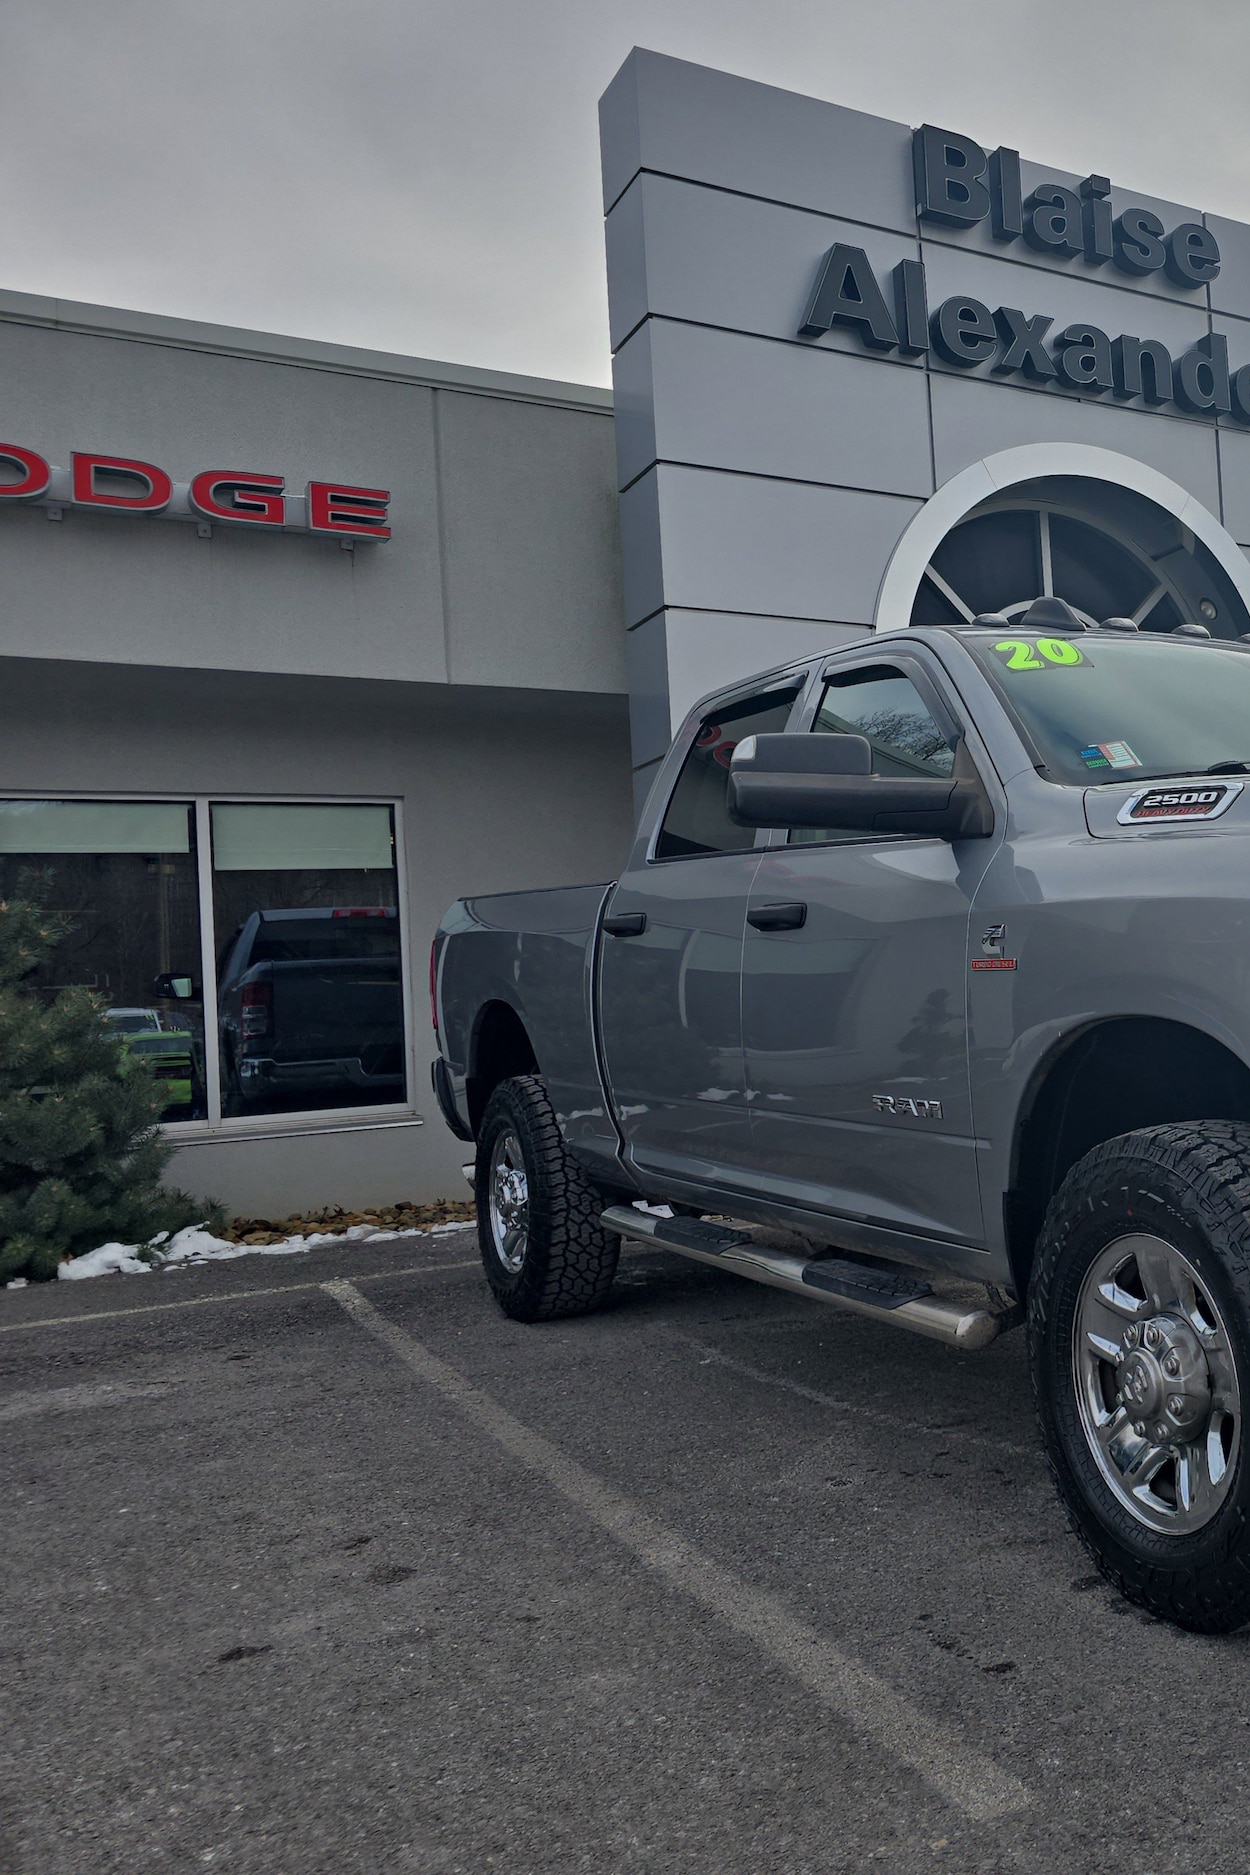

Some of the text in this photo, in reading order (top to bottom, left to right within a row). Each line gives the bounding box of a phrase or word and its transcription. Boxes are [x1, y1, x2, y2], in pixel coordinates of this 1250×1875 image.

[913, 123, 1221, 289] Blaise
[995, 638, 1084, 671] 20
[1136, 806, 1211, 817] HEAVY DUTY
[1143, 791, 1218, 807] 2500
[872, 1094, 943, 1119] RAM
